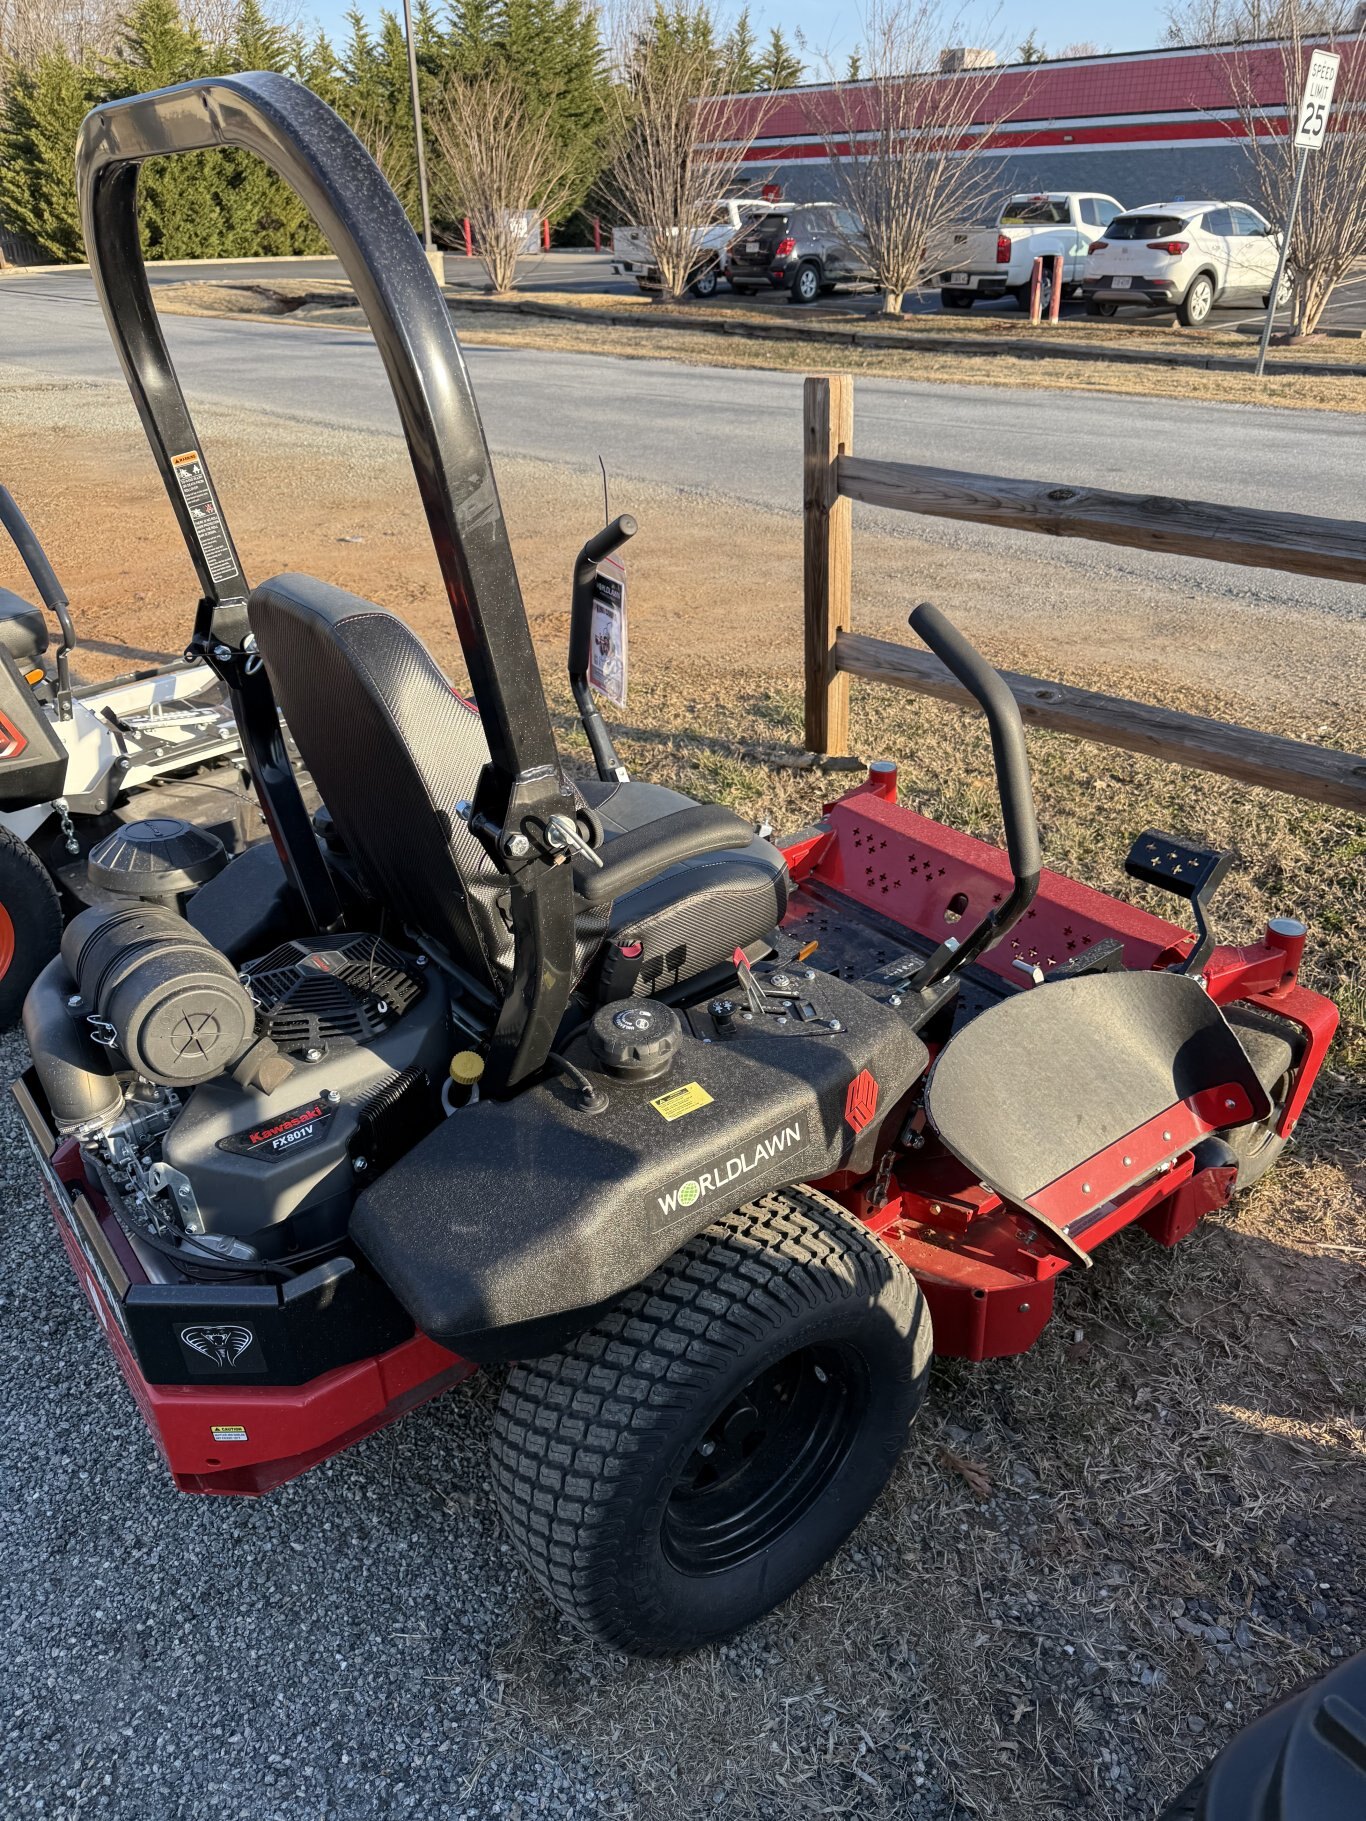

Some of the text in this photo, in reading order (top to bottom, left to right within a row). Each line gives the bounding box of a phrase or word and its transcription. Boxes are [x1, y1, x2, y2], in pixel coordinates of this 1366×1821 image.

[1311, 63, 1335, 81] SPEED
[1309, 83, 1329, 100] LIMIT
[1301, 102, 1326, 136] 25
[249, 1106, 322, 1144] Kawasaki
[272, 1124, 313, 1149] FX801V
[657, 1122, 801, 1216] WORLDLAWN
